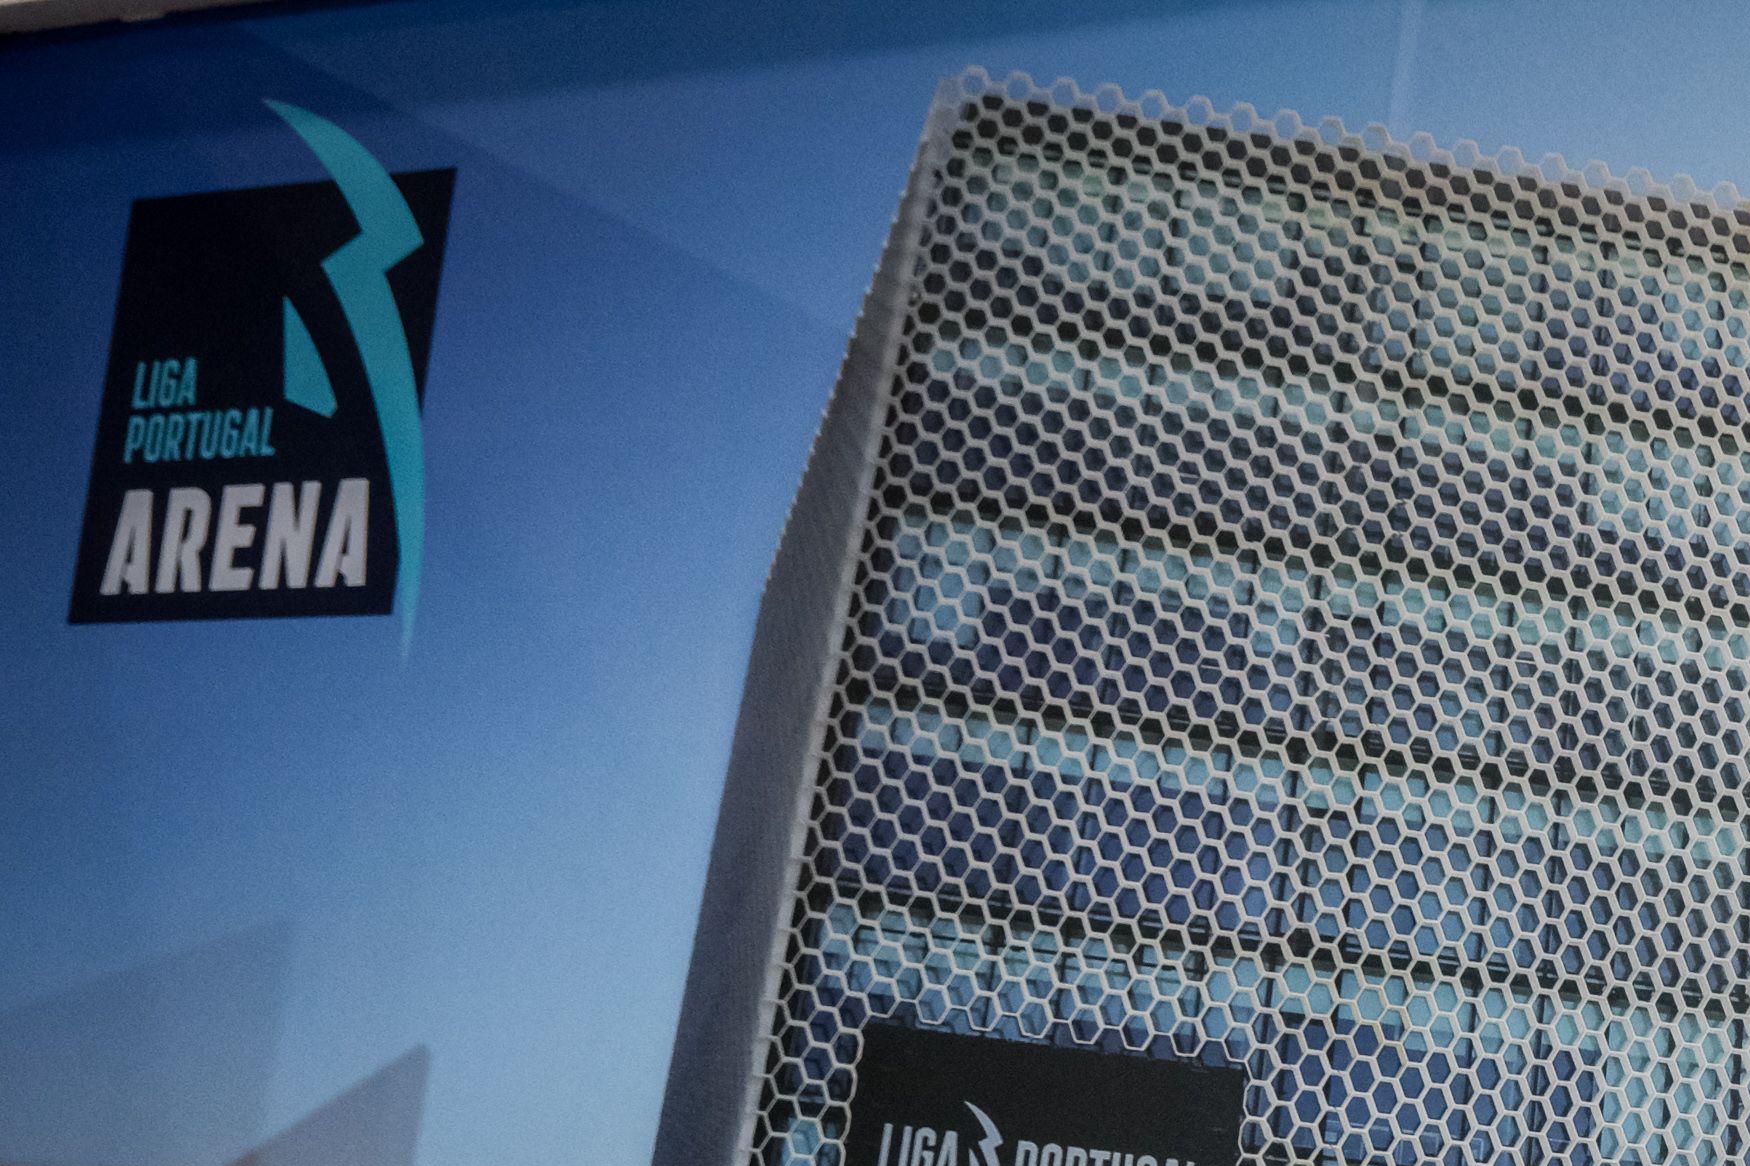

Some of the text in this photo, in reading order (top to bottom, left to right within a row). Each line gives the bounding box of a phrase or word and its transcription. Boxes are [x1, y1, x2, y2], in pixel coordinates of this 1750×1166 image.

[131, 357, 198, 409] LIGA
[123, 406, 276, 464] PORTUGAL
[100, 477, 371, 596] ARENA
